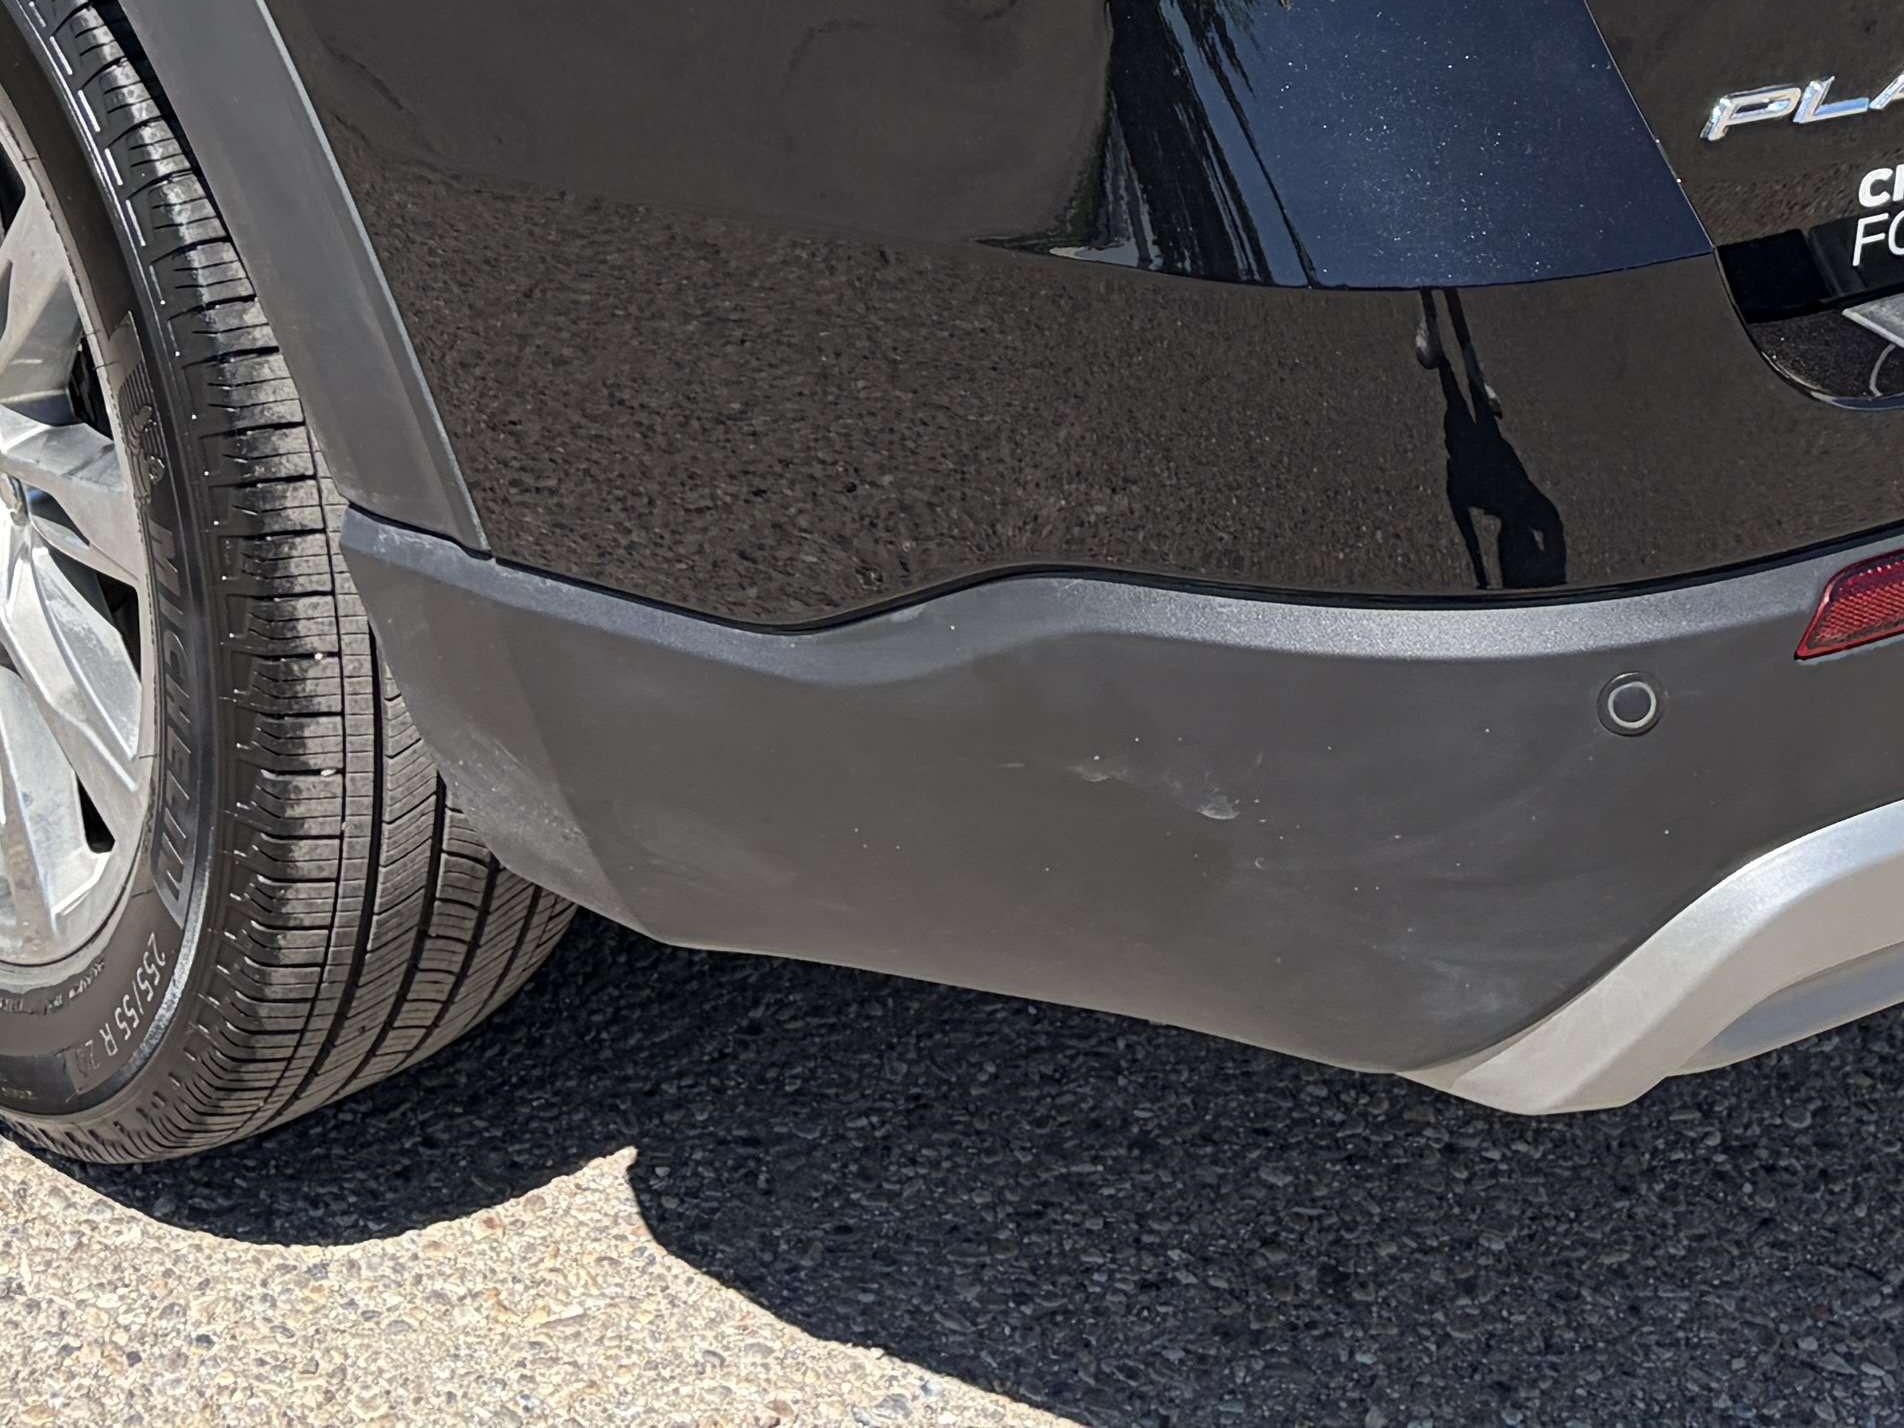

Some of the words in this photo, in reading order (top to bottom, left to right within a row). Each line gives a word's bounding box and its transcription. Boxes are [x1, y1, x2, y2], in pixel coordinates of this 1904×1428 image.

[147, 517, 192, 903] MICHELIN
[98, 1021, 120, 1057] R
[114, 931, 167, 1041] 255/55
